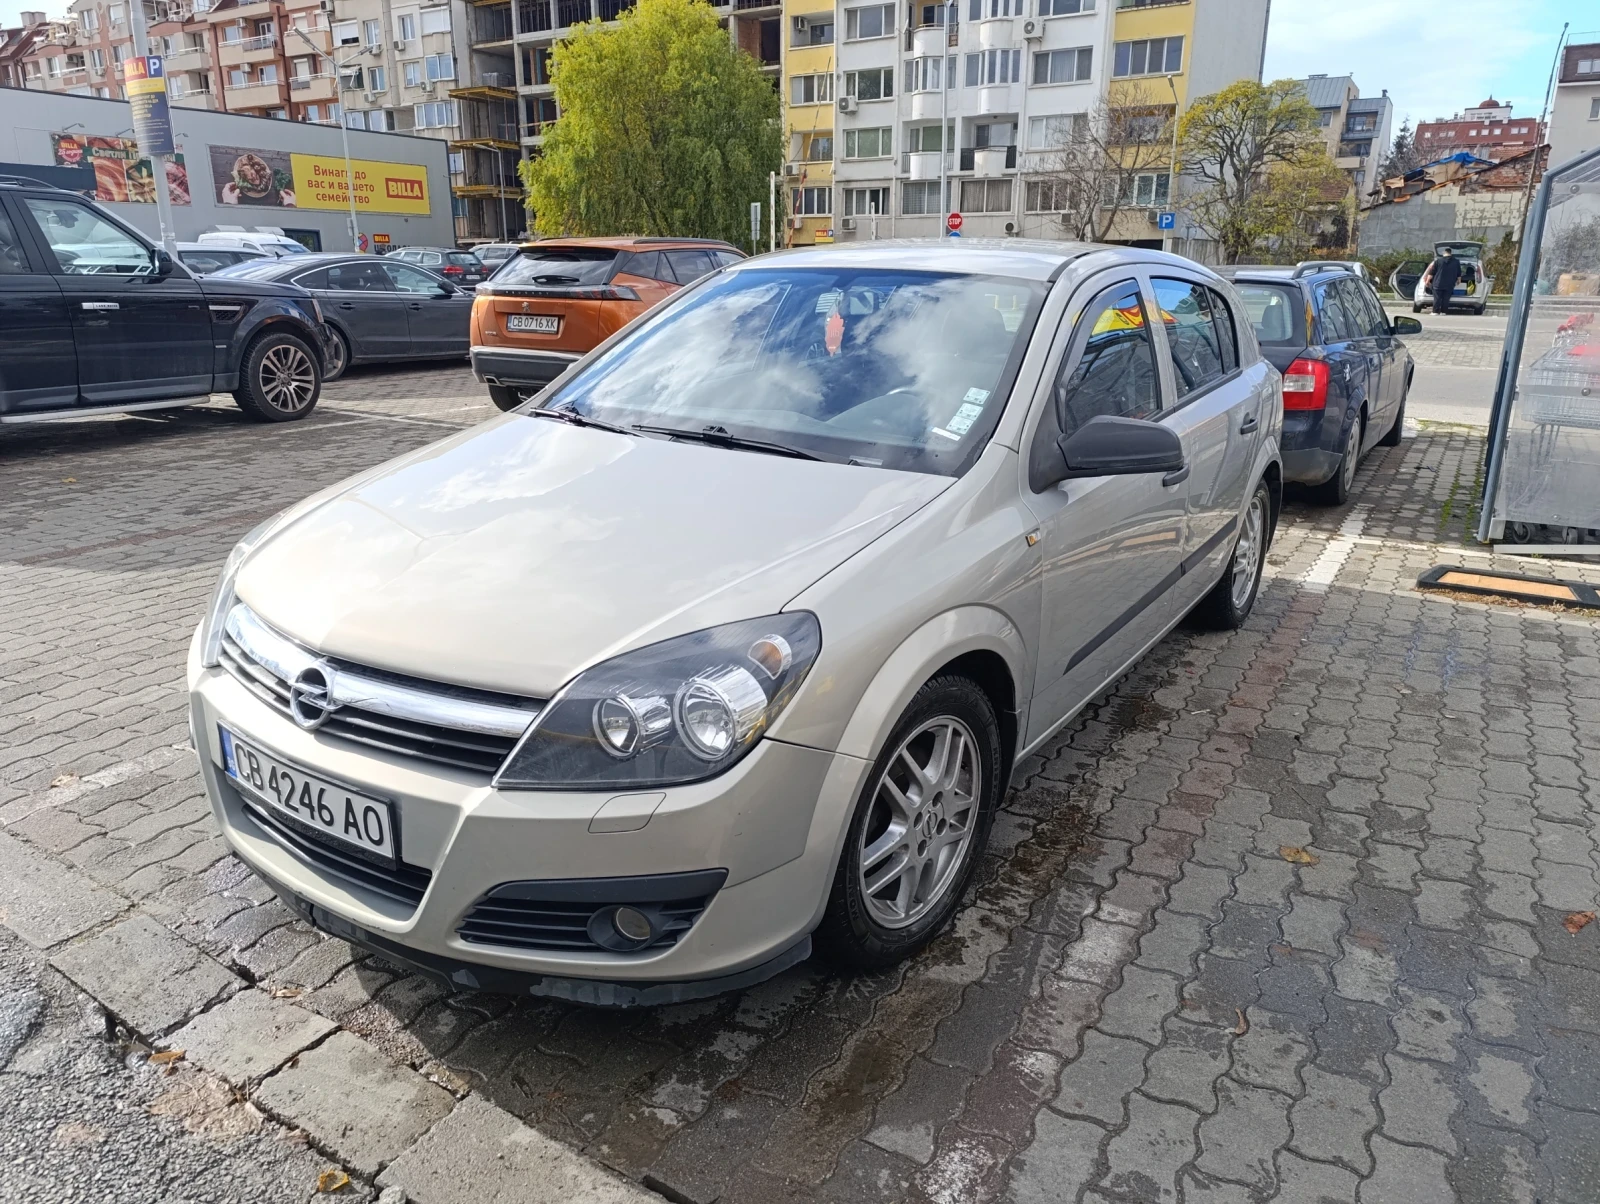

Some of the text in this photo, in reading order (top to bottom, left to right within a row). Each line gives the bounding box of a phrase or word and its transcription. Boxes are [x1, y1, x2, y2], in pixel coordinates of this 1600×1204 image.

[149, 58, 160, 75] P
[355, 171, 366, 180] до
[307, 179, 326, 189] вас
[328, 181, 335, 190] и
[388, 181, 421, 196] BILLA
[1162, 215, 1171, 227] P
[512, 317, 556, 329] CB 0716 XK
[234, 742, 264, 792] CB
[268, 764, 335, 828] 4246
[344, 797, 384, 846] AO
